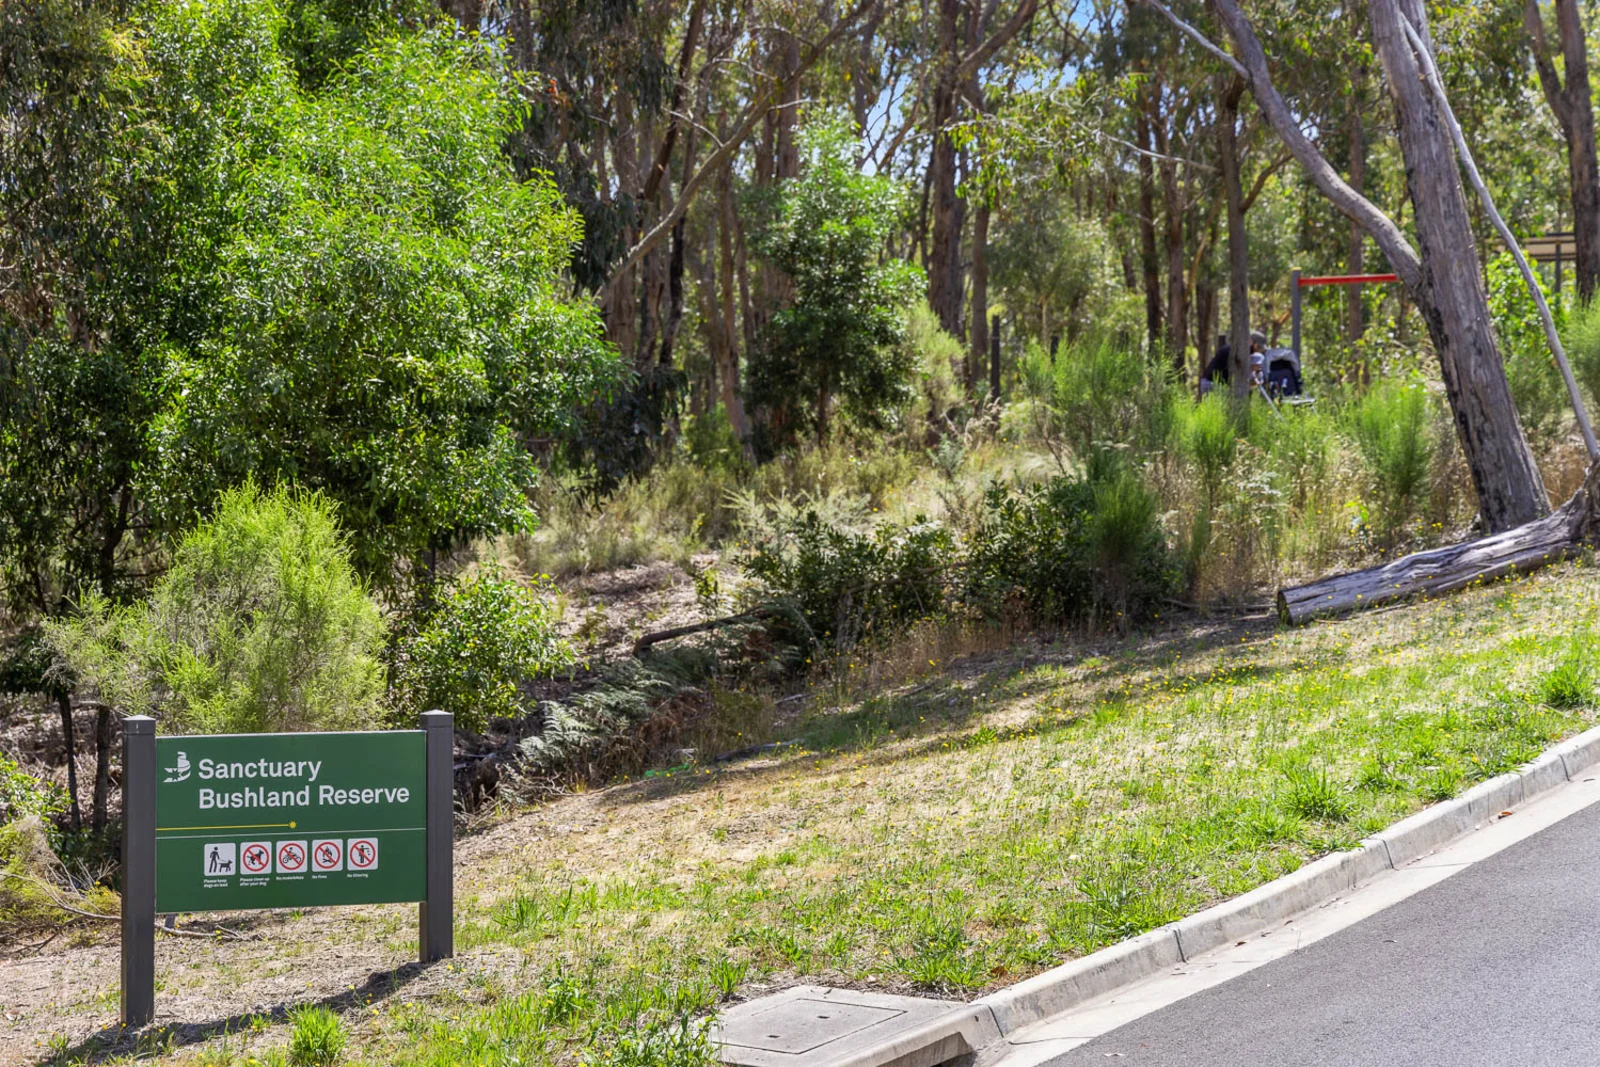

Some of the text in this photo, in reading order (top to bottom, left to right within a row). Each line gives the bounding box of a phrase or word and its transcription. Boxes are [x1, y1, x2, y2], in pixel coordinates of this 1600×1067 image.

[198, 758, 322, 781] Sanctuary
[199, 785, 410, 809] Bushland Reserve
